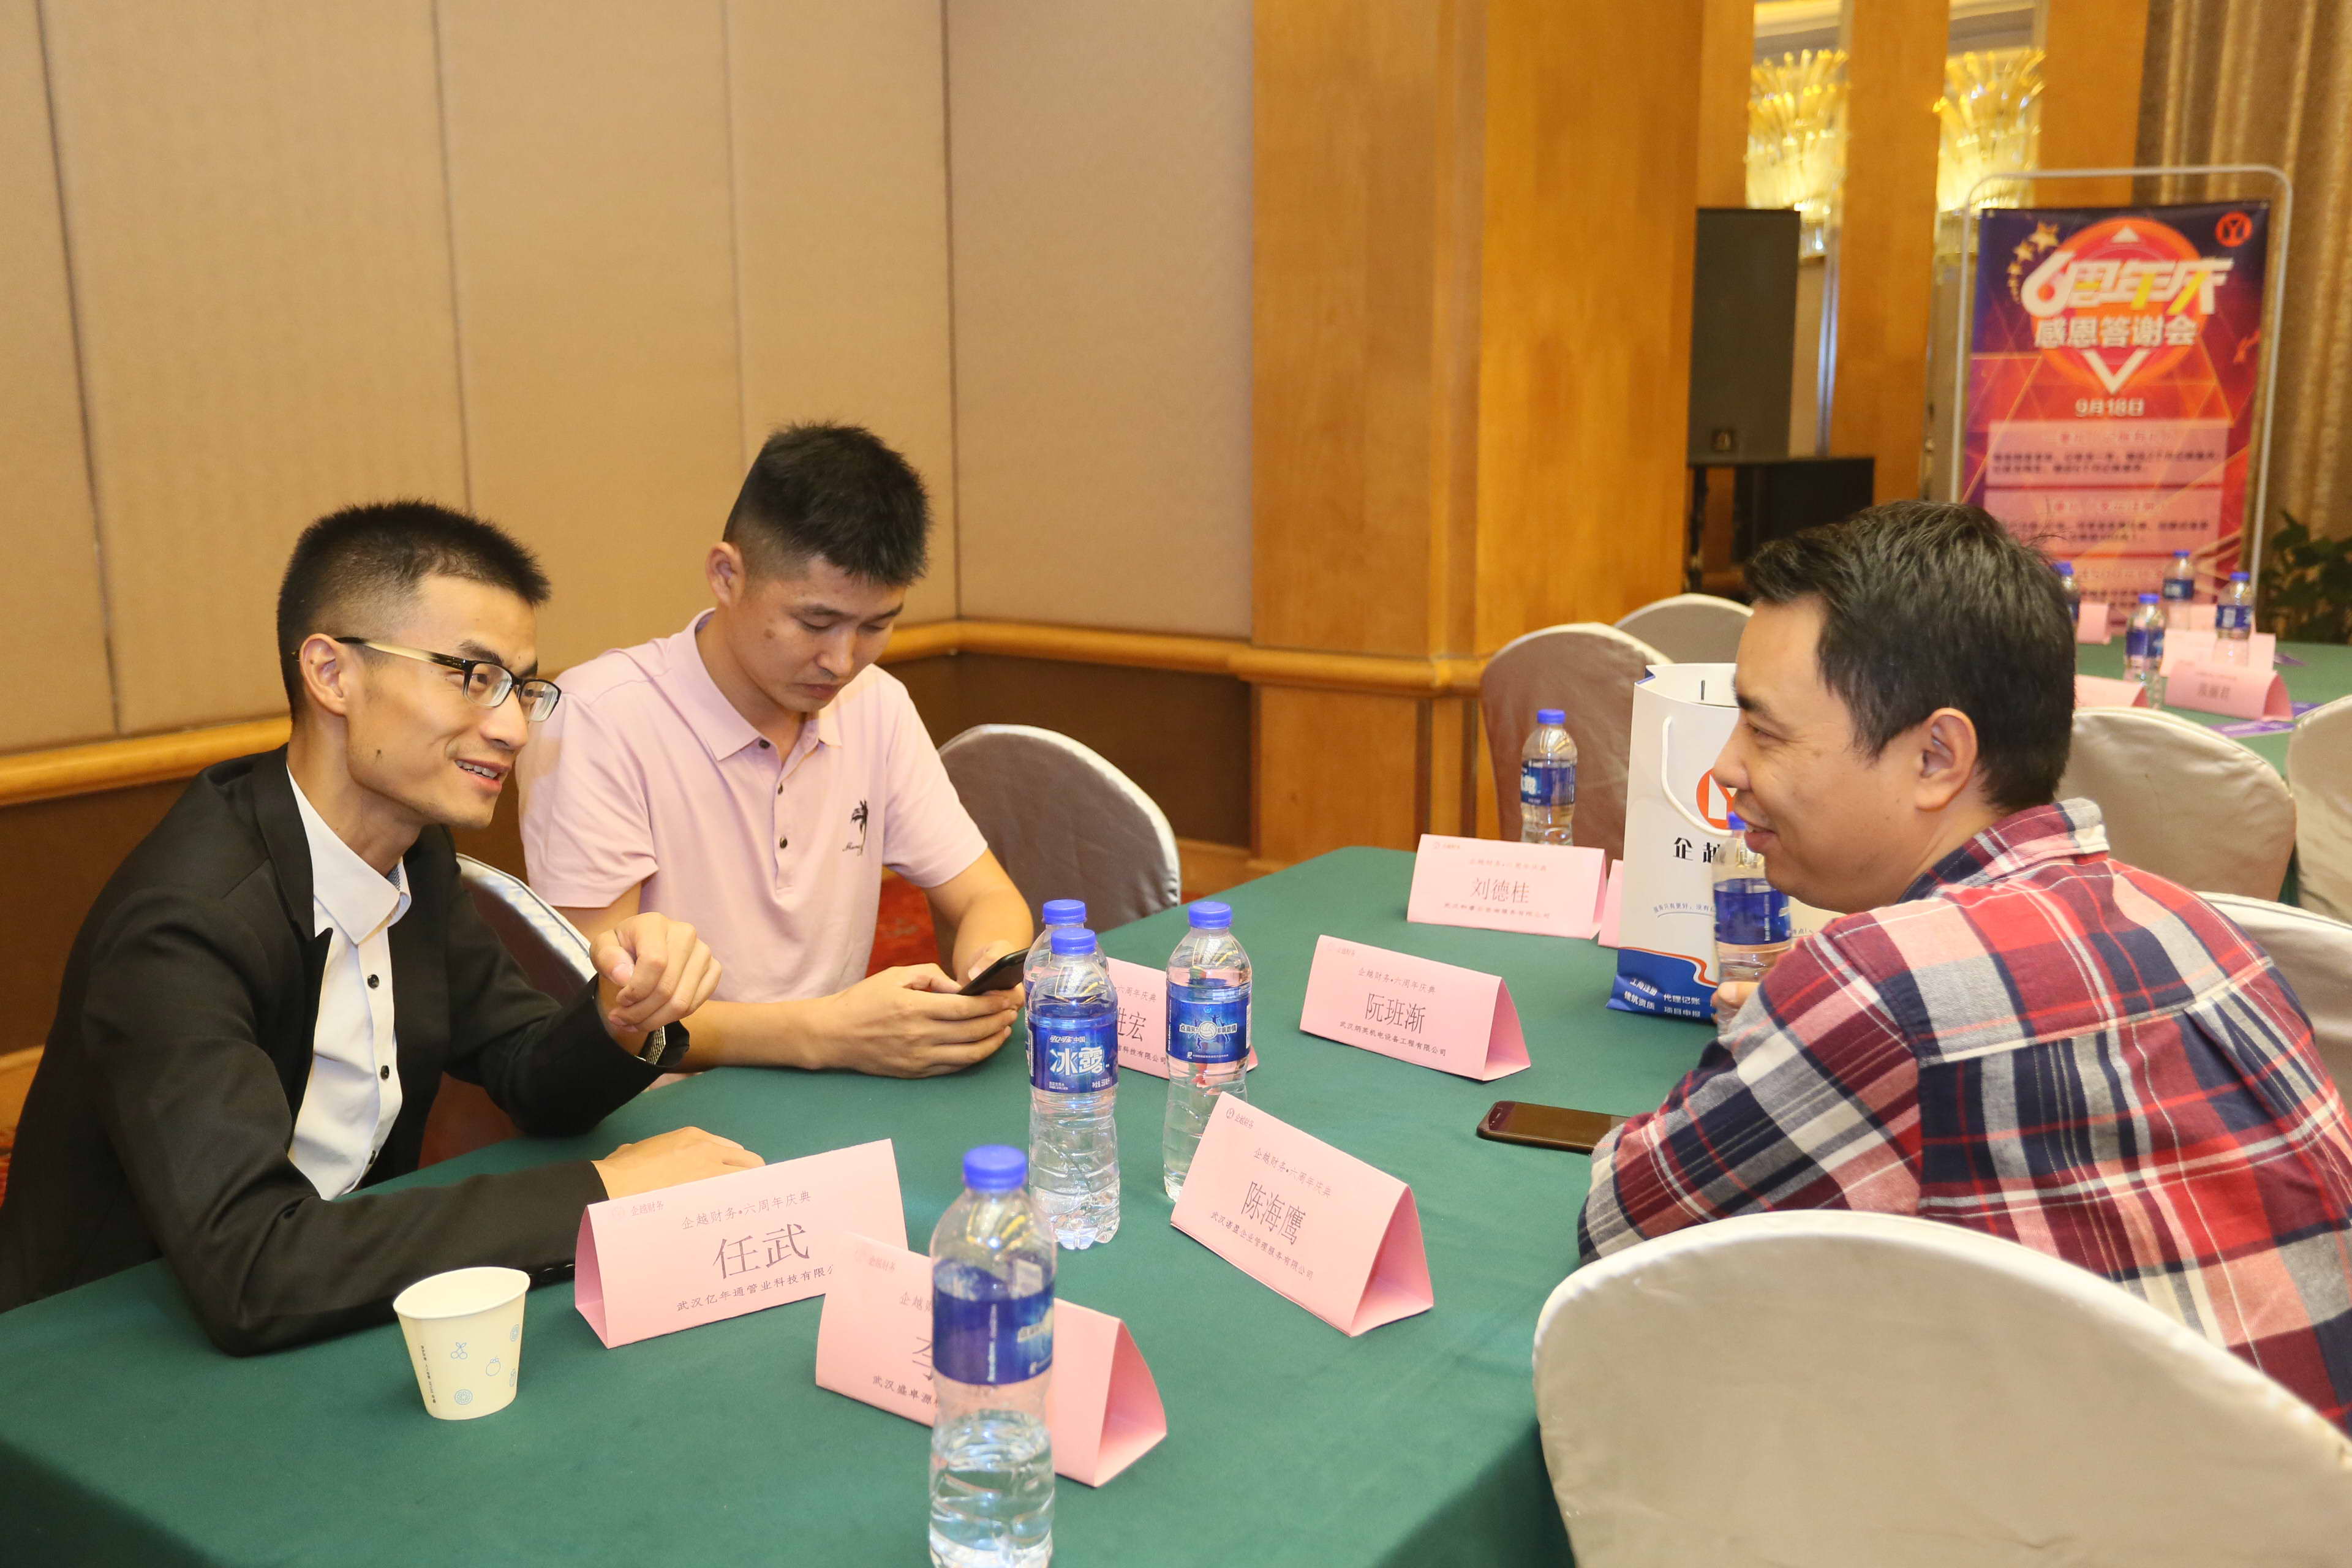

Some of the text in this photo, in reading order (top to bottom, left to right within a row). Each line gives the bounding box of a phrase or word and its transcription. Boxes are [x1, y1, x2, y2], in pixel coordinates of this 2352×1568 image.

[2021, 252, 2234, 318] 6周年庆
[2034, 314, 2198, 349] 感恩答谢会
[2075, 398, 2145, 418] 9月18日
[1470, 876, 1530, 904] 刘德桂
[1365, 993, 1427, 1035] 阮班渐
[1664, 993, 1701, 1006] 代理记账
[1049, 1046, 1104, 1076] 冰露
[1240, 1180, 1306, 1246] 陈海鹰
[712, 1223, 810, 1280] 任武
